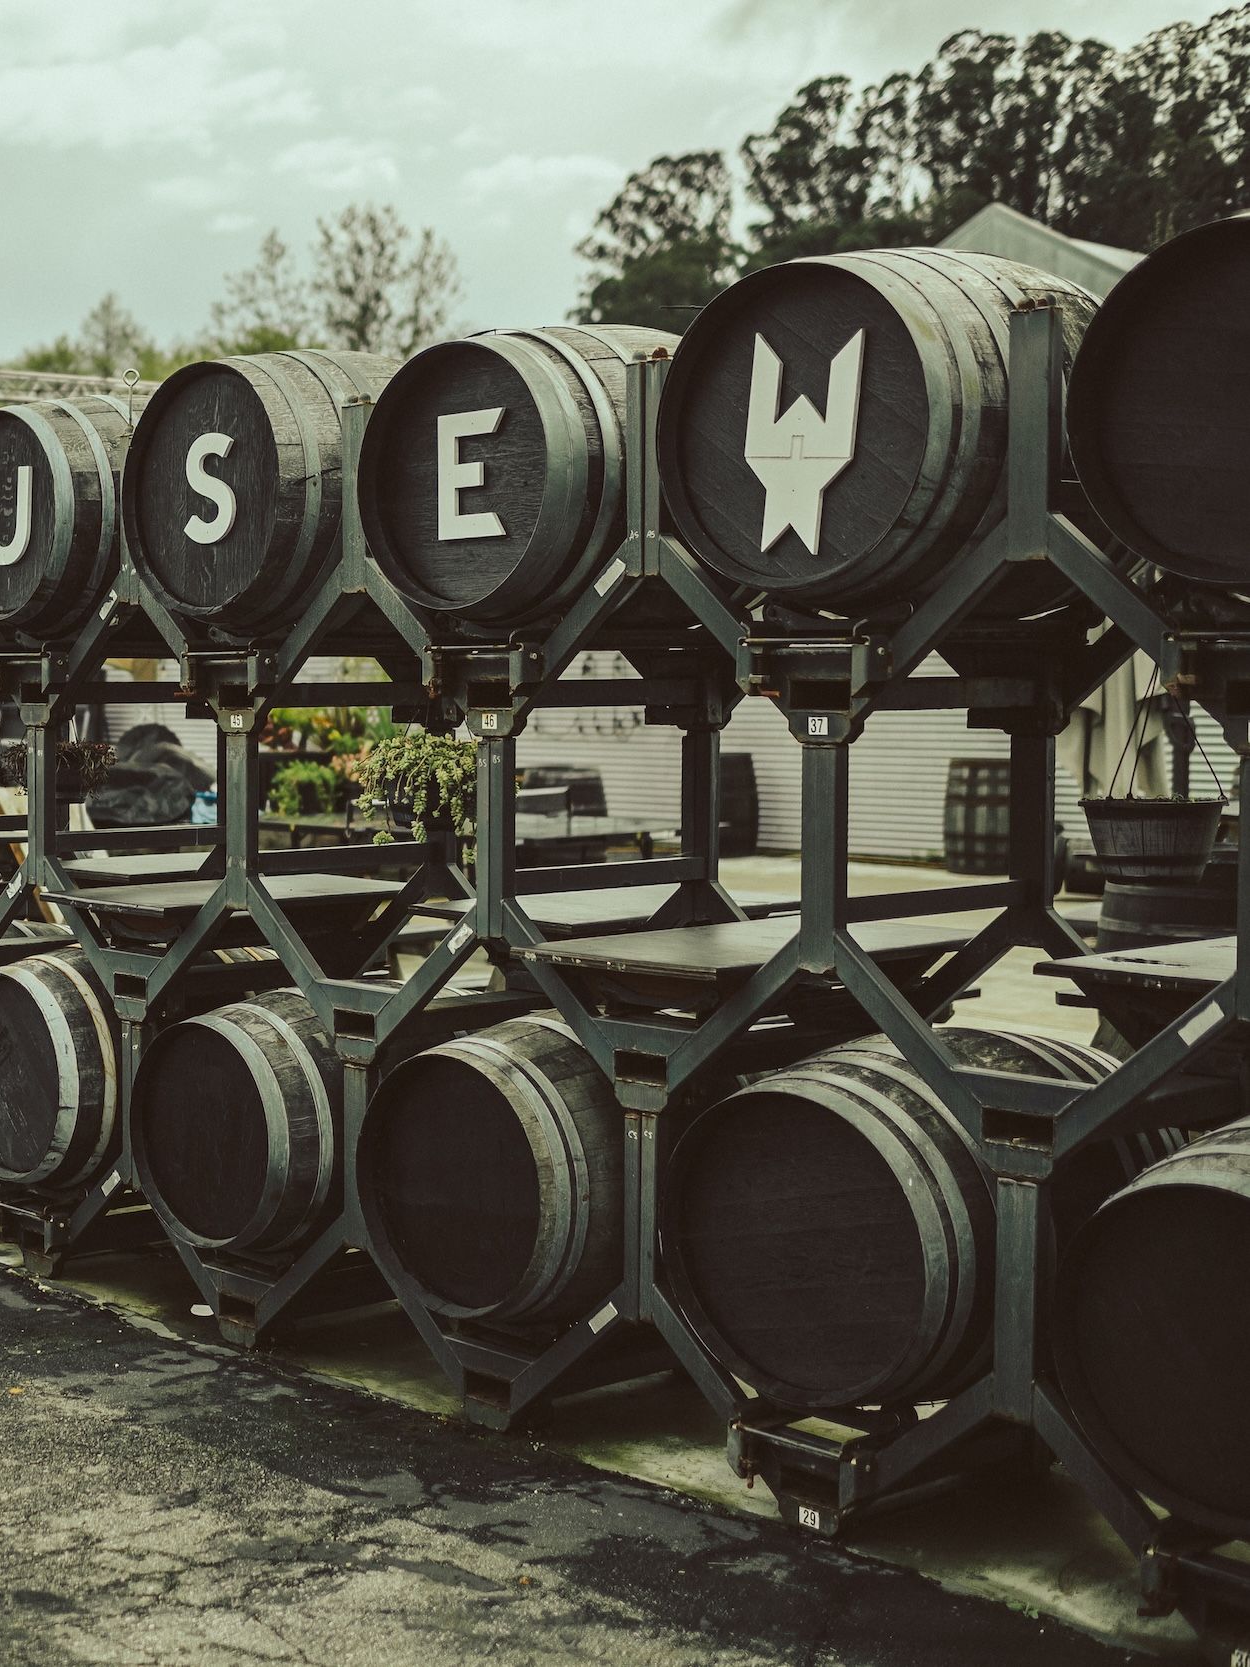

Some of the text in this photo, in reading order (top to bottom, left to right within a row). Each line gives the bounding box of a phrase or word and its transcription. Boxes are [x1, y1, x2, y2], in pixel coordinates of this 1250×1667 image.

[484, 714, 495, 728] 46
[810, 718, 823, 733] 37
[803, 1509, 816, 1526] 29
